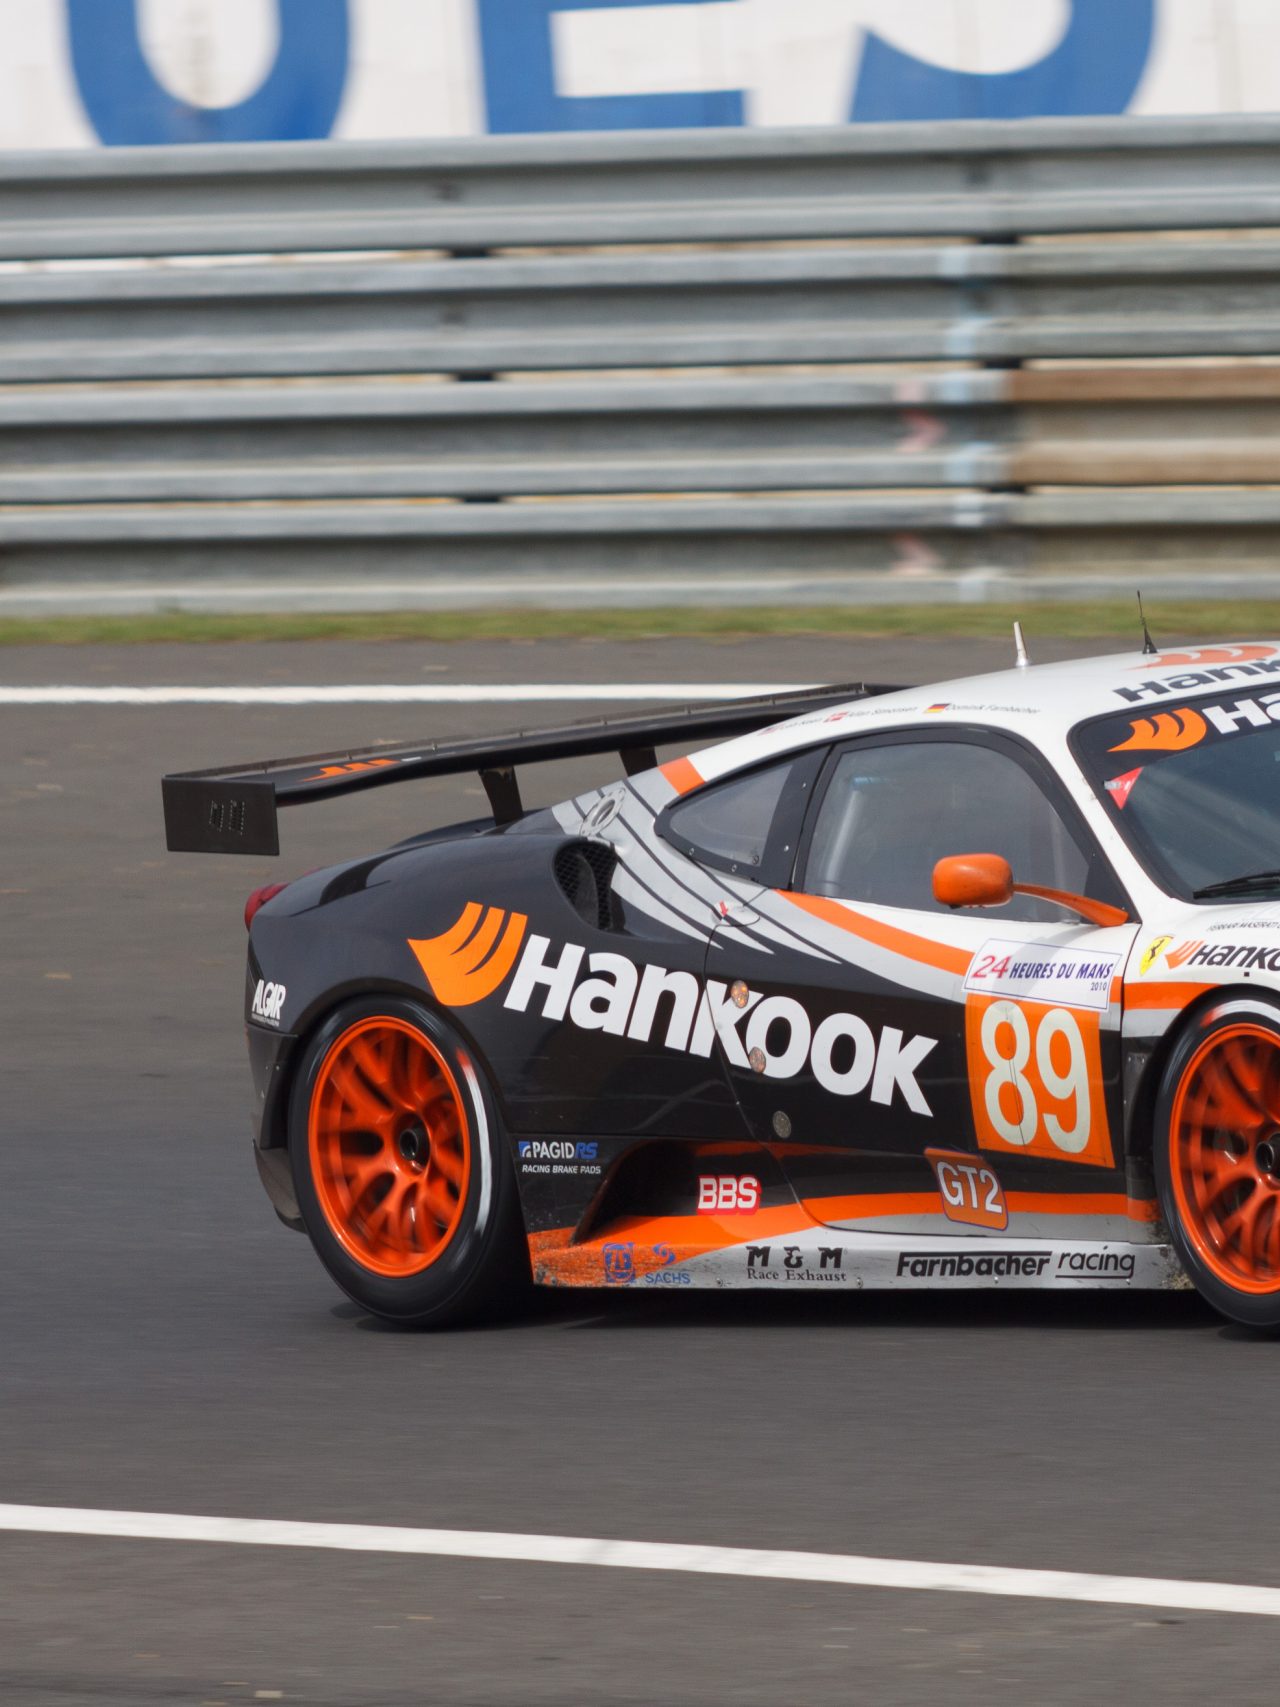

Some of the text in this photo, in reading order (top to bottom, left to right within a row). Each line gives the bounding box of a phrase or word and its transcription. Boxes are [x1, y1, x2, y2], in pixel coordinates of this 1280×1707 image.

[971, 955, 1114, 979] 24 HEURES DU MANS
[1090, 981, 1107, 991] 2010
[980, 1000, 1092, 1155] 89
[522, 1164, 602, 1175] RACING BRAKE PADS
[697, 1177, 758, 1210] BBS
[937, 1161, 1003, 1214] GT2
[746, 1246, 843, 1269] M & M
[896, 1245, 1137, 1279] Farnbacher racing
[645, 1272, 691, 1285] SACHS
[746, 1268, 847, 1282] Race Exhaust
